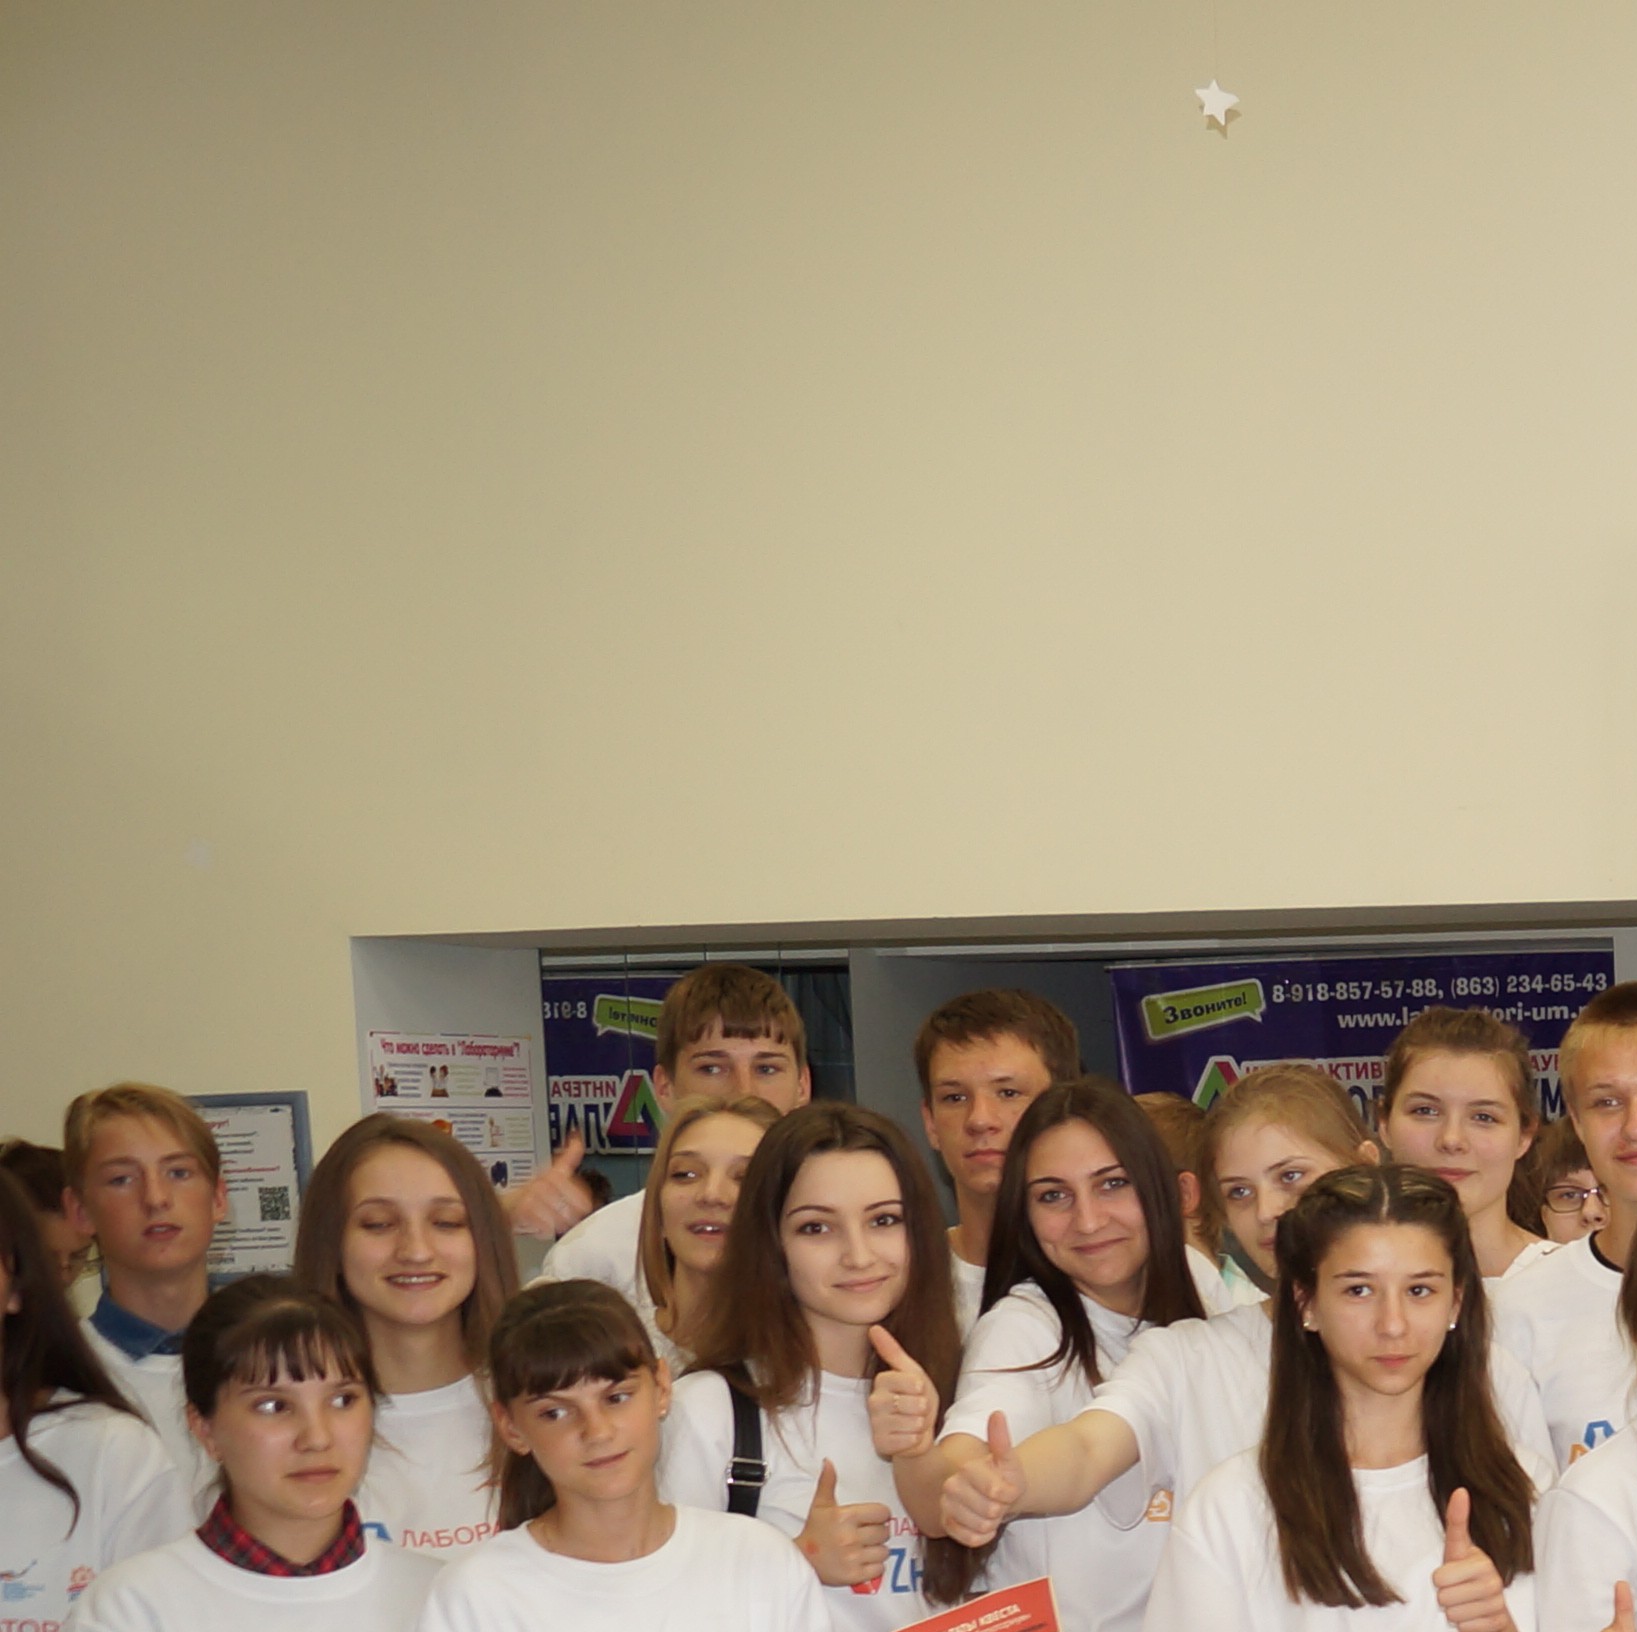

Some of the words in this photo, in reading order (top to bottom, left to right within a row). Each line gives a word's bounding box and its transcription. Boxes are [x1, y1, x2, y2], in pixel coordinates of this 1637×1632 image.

[1271, 978, 1444, 1004] 8-918-857-57-88,
[1449, 976, 1500, 999] (863)
[1506, 972, 1608, 993] 234-65-43
[1162, 992, 1248, 1025] Звоните!
